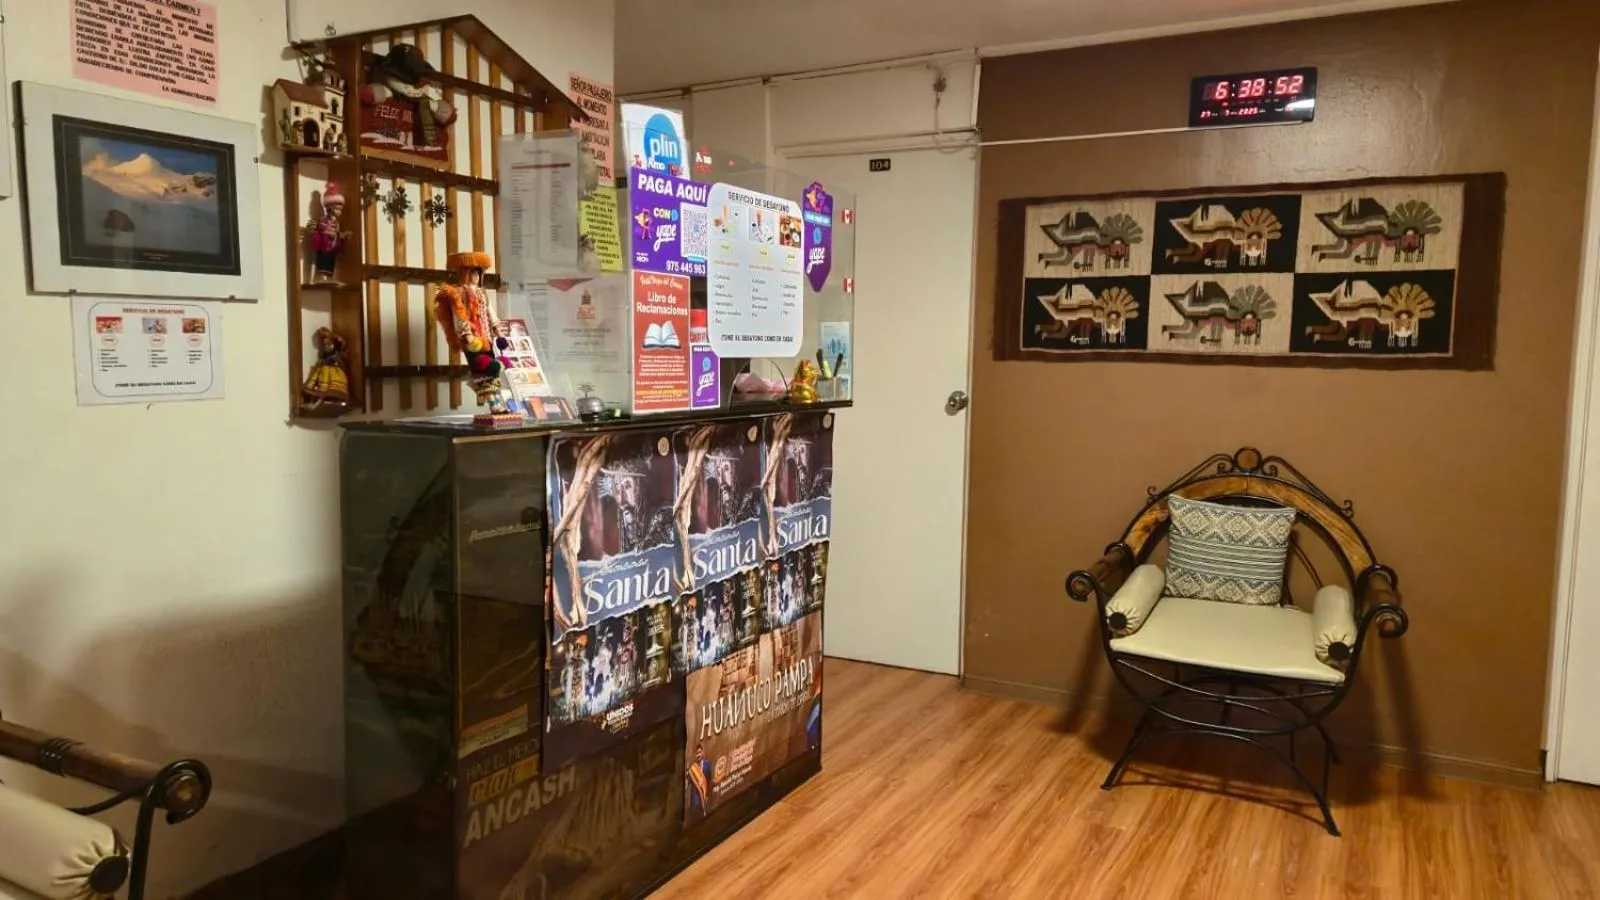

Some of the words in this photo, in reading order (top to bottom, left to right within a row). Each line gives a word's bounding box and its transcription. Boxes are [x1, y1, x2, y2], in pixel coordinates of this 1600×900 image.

[649, 134, 678, 159] plin
[872, 161, 888, 170] 104
[638, 174, 673, 196] PAGA
[676, 180, 706, 203] AQUÍ
[728, 191, 753, 205] SERVICIO
[653, 207, 670, 219] CON
[653, 224, 676, 252] yape
[636, 302, 688, 316] Reclamaciones
[648, 292, 666, 303] Libro
[668, 293, 676, 304] de
[777, 513, 828, 548] Santa
[692, 536, 756, 580] Santa
[584, 562, 670, 615] Santa
[463, 764, 576, 848] ANCASH
